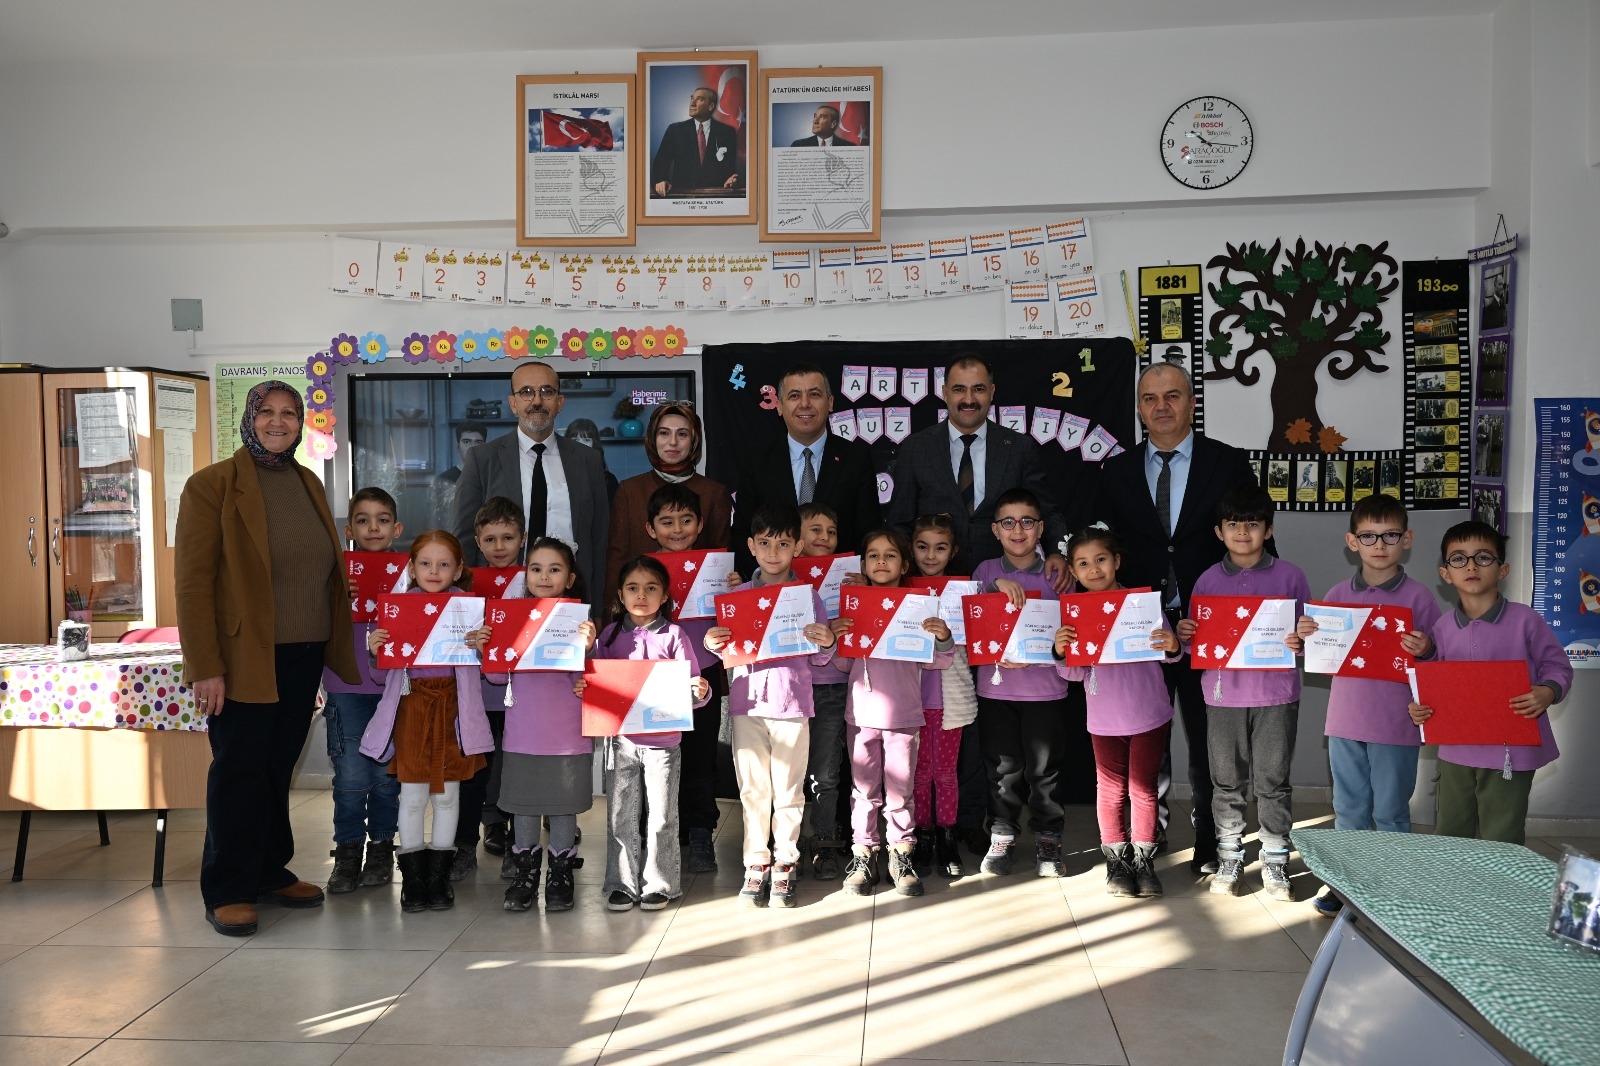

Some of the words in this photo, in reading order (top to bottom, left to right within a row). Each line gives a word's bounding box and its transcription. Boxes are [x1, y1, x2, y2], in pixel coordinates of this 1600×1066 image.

[1202, 102, 1214, 111] 12
[1167, 139, 1174, 148] 9
[1240, 136, 1248, 146] 3
[1202, 175, 1210, 184] 6
[1023, 250, 1040, 266] 16
[1061, 243, 1076, 260] 17
[349, 263, 359, 277] 0
[941, 261, 958, 277] 14
[983, 255, 1001, 272] 15
[398, 267, 402, 281] 1
[435, 268, 445, 284] 2
[476, 271, 486, 286] 3
[525, 273, 536, 288] 4
[783, 273, 800, 288] 10
[833, 270, 845, 286] 11
[866, 268, 883, 284] 12
[903, 266, 920, 282] 13
[572, 276, 582, 291] 5
[616, 278, 625, 292] 6
[657, 276, 667, 292] 7
[703, 276, 711, 291] 8
[744, 276, 753, 291] 9
[1155, 275, 1186, 289] 1881
[1023, 306, 1038, 322] 19
[1069, 301, 1091, 319] 20
[1078, 348, 1096, 372] 1
[221, 367, 268, 377] DAVRANIŞ
[729, 364, 746, 390] 4
[1051, 372, 1073, 397] 2
[759, 385, 778, 409] 3
